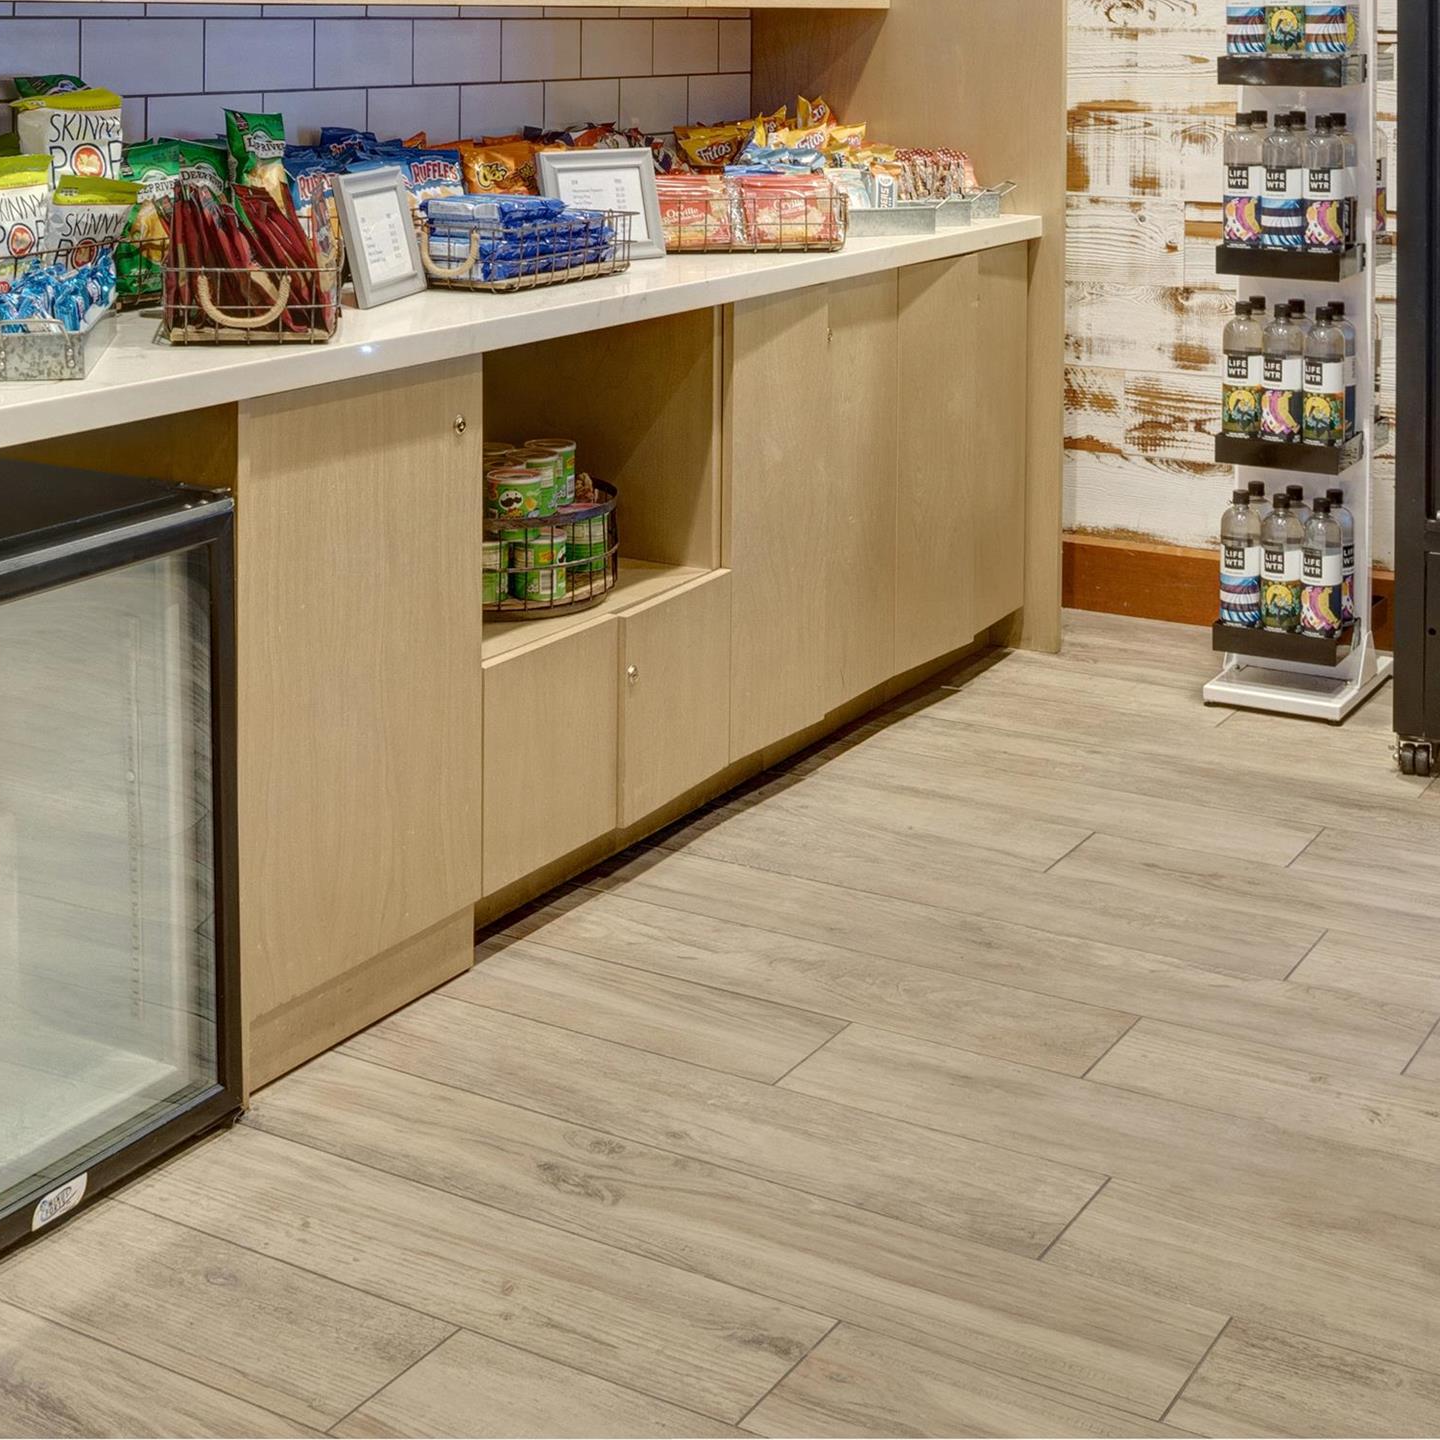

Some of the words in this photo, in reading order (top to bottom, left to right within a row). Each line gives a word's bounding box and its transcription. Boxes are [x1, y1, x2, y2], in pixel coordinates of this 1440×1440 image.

[697, 143, 732, 161] Fritos
[412, 162, 458, 182] RUFFLES
[1228, 169, 1248, 178] LIFE
[1266, 172, 1286, 181] LIFE
[1310, 172, 1330, 181] LIFE
[1228, 178, 1248, 187] WTR
[1266, 182, 1286, 191] WTR
[1310, 182, 1330, 191] WTR
[62, 209, 124, 237] SKINNY
[1228, 359, 1247, 368] LIFE
[1263, 362, 1282, 371] LIFE
[1228, 369, 1247, 378] WTR
[1304, 365, 1322, 374] LIFE
[1263, 372, 1282, 381] WTR
[1304, 375, 1322, 384] WTR
[1225, 550, 1244, 559] LIFE
[1264, 553, 1283, 562] LIFE
[1225, 560, 1244, 569] WTR
[1303, 556, 1321, 565] LIFE
[1264, 563, 1283, 572] WTR
[1303, 566, 1321, 575] WTR
